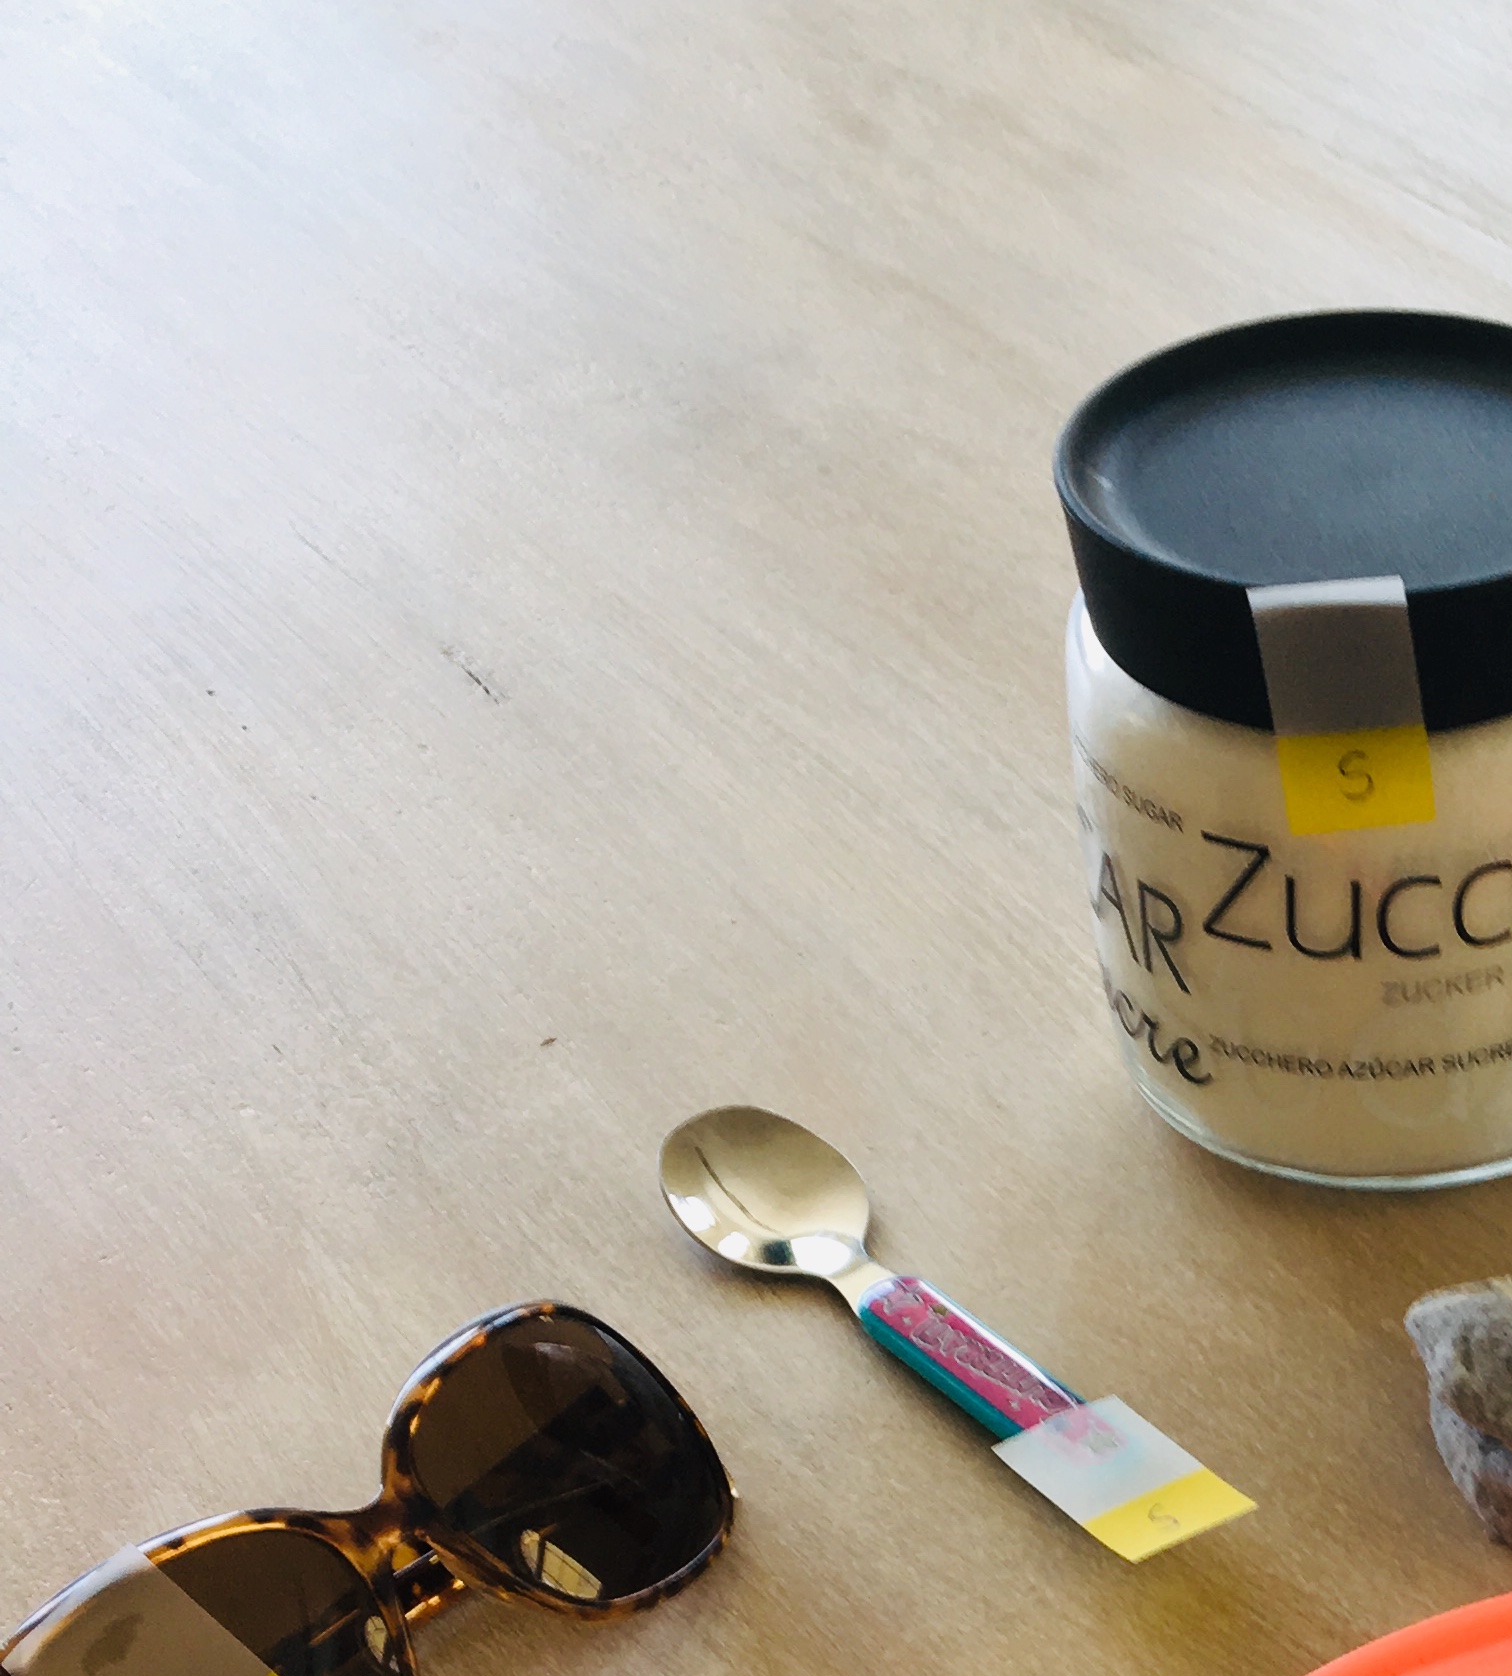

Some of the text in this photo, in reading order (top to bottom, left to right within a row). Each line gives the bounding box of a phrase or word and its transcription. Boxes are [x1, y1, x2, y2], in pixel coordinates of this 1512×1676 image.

[1337, 749, 1376, 804] S
[1121, 784, 1185, 834] SUGAR
[1381, 963, 1505, 1006] ZUCKER
[1208, 1032, 1334, 1079] ZUCCHERO
[1147, 1502, 1180, 1532] S
